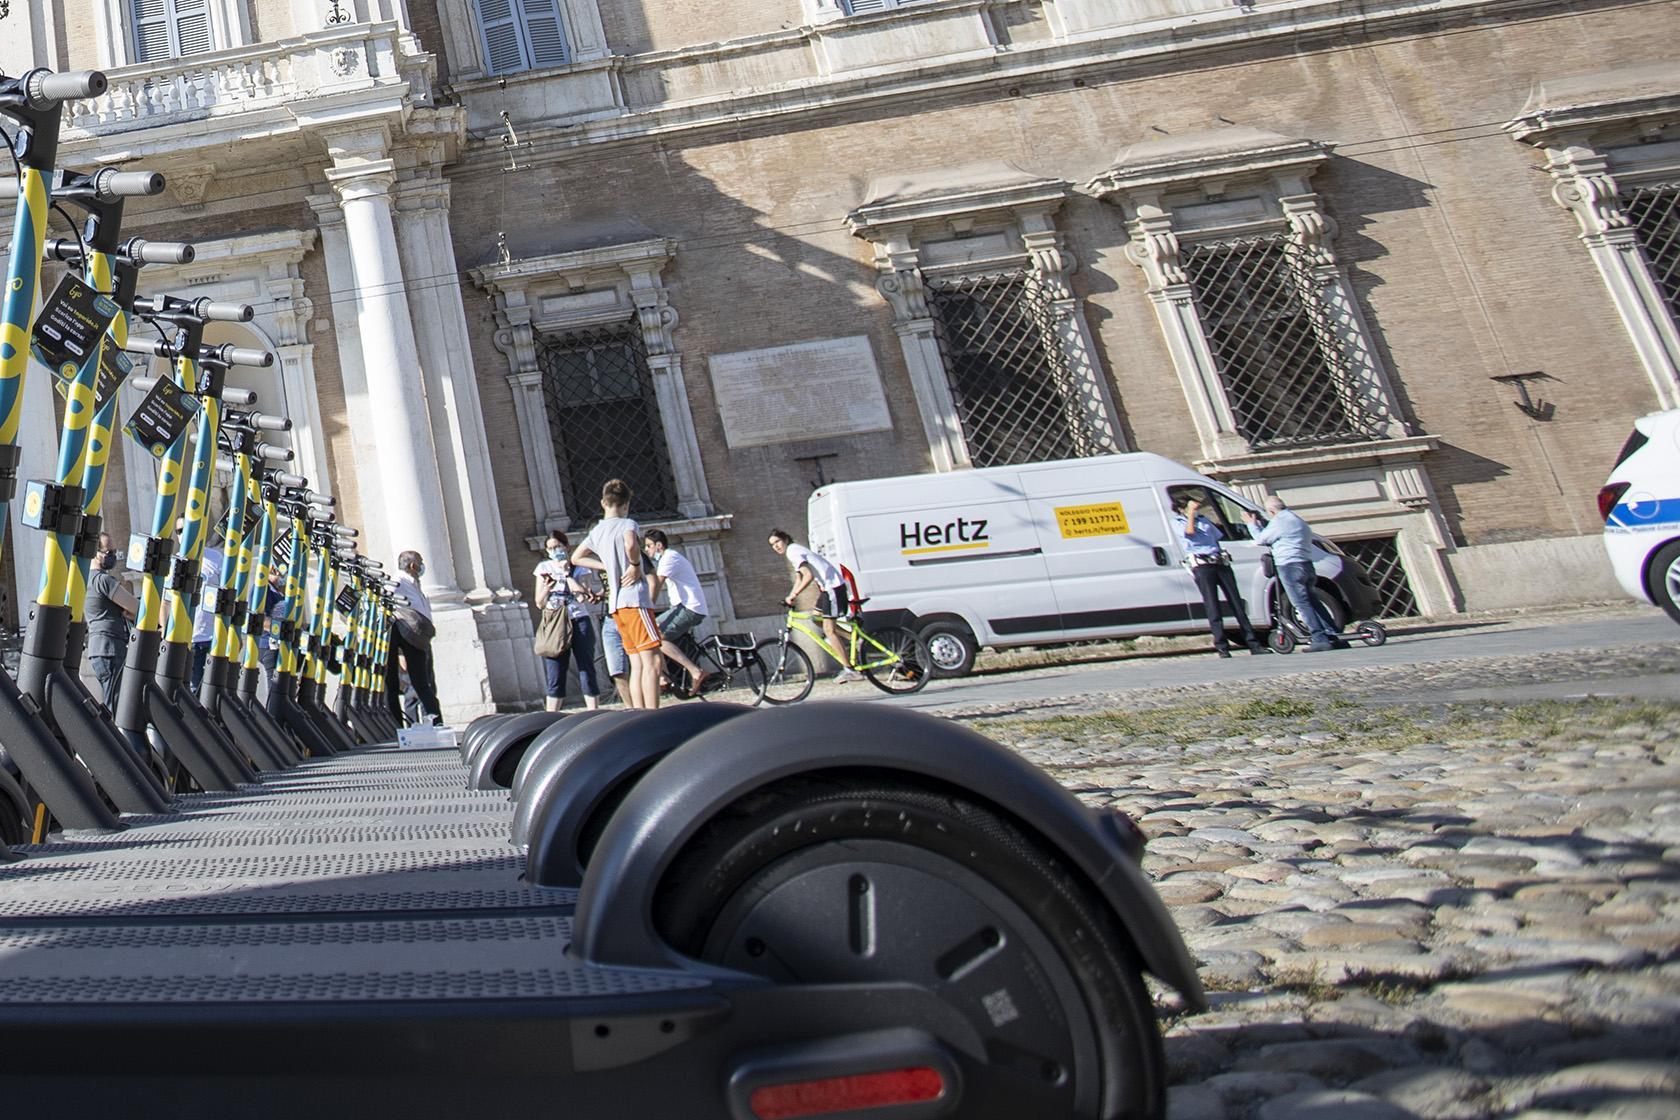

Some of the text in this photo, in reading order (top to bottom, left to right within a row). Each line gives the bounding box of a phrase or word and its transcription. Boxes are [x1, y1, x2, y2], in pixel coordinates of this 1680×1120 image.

[1071, 514, 1121, 526] 199 117711
[900, 517, 989, 548] Hertz
